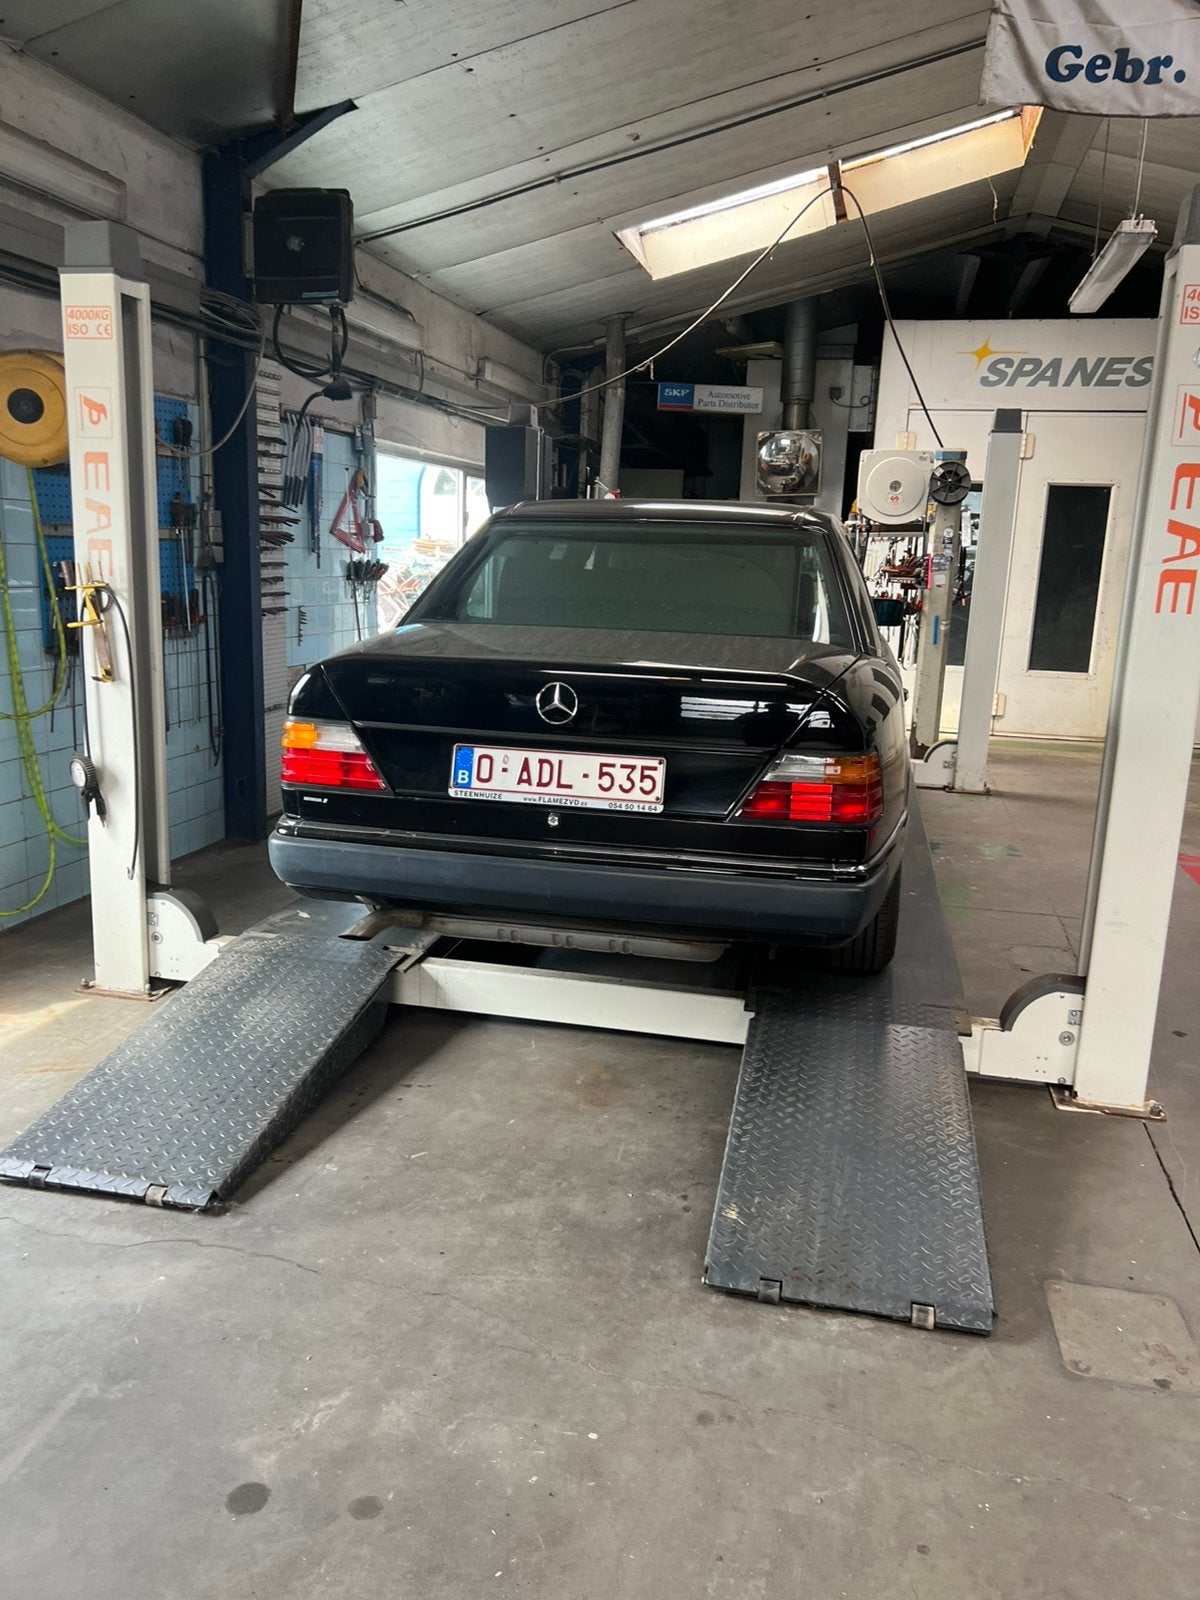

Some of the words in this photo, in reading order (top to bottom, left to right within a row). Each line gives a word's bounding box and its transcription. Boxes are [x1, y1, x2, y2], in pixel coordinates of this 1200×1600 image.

[1045, 45, 1186, 85] Gebr.
[67, 309, 109, 321] 4000KG
[68, 323, 88, 335] ISO
[664, 388, 689, 397] SKF
[707, 391, 751, 400] Automotive
[698, 399, 717, 408] Parts
[718, 400, 760, 410] Distributor
[457, 770, 469, 784] B
[454, 790, 502, 799] STEENHUIZE
